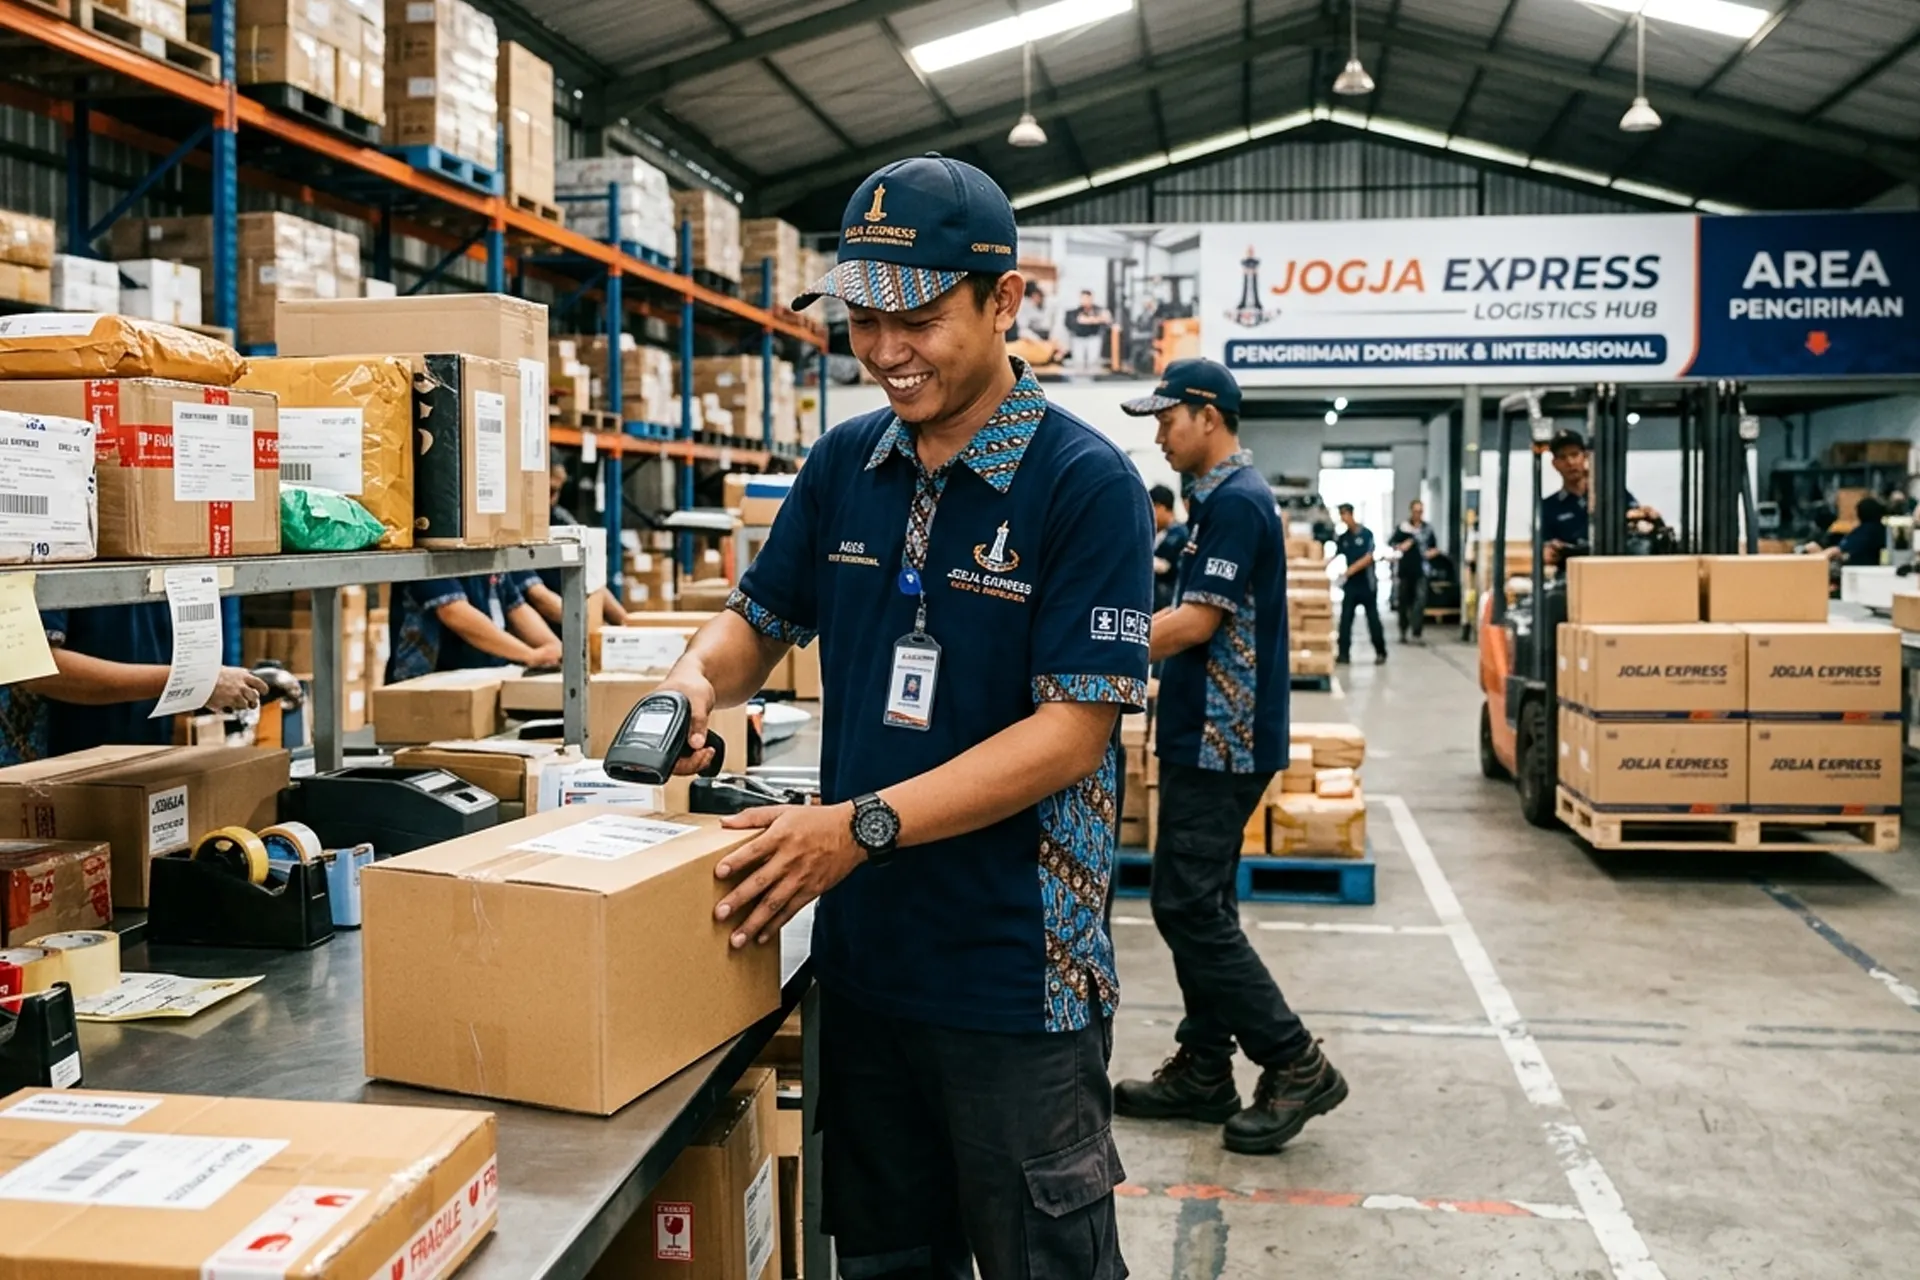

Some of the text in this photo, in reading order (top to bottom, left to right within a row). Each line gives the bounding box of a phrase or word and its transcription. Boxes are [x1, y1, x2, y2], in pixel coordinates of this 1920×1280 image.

[1271, 254, 1662, 295] JOGJA EXPRESS
[1742, 249, 1891, 289] AREA
[1473, 301, 1658, 321] LOGISTICS HUB
[1729, 296, 1904, 320] PENGIRIMAN
[1231, 340, 1658, 363] PENGIRIMAN DOMESTIK & INTERNASIONAL
[1665, 665, 1728, 678] EXPRESS
[410, 1200, 461, 1273] FRAGILE
